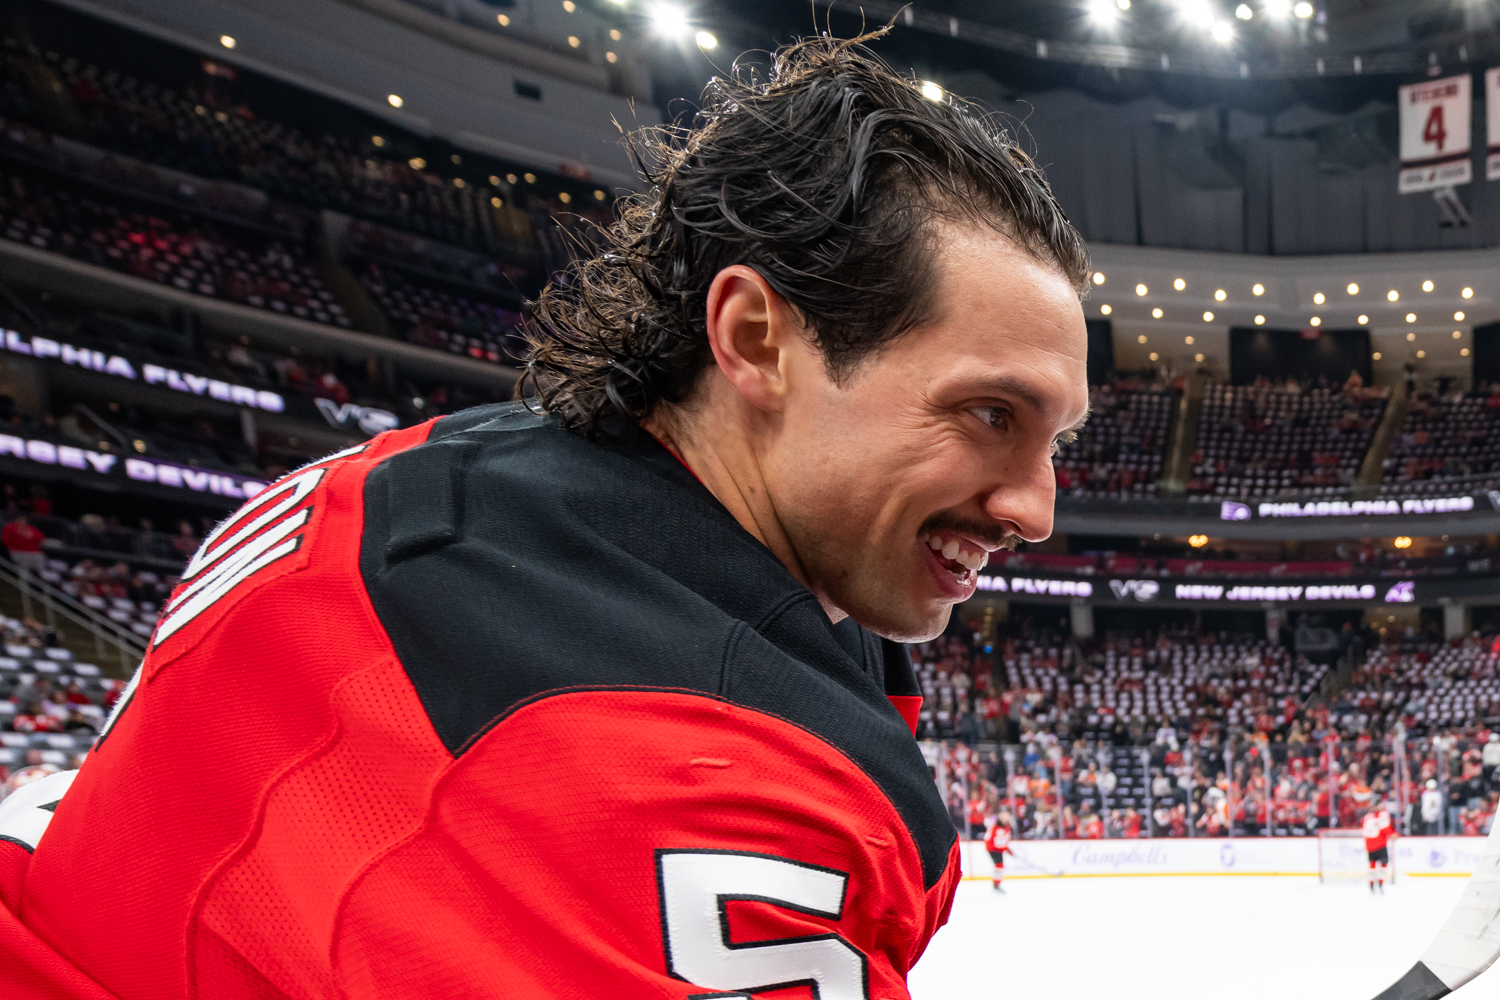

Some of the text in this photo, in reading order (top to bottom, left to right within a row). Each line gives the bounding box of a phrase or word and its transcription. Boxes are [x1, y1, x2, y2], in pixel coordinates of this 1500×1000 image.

[1423, 105, 1446, 151] 4
[0, 328, 285, 413] LPHIA FLYERS
[314, 398, 400, 435] VS
[1258, 500, 1400, 518] PHILADELPHIA
[1402, 495, 1475, 514] FLYERS
[1011, 577, 1093, 598] FLYERS
[1109, 579, 1160, 600] VS
[1174, 584, 1225, 600] NEW
[1225, 585, 1304, 601] JERSEY
[1304, 584, 1377, 600] DEVILS
